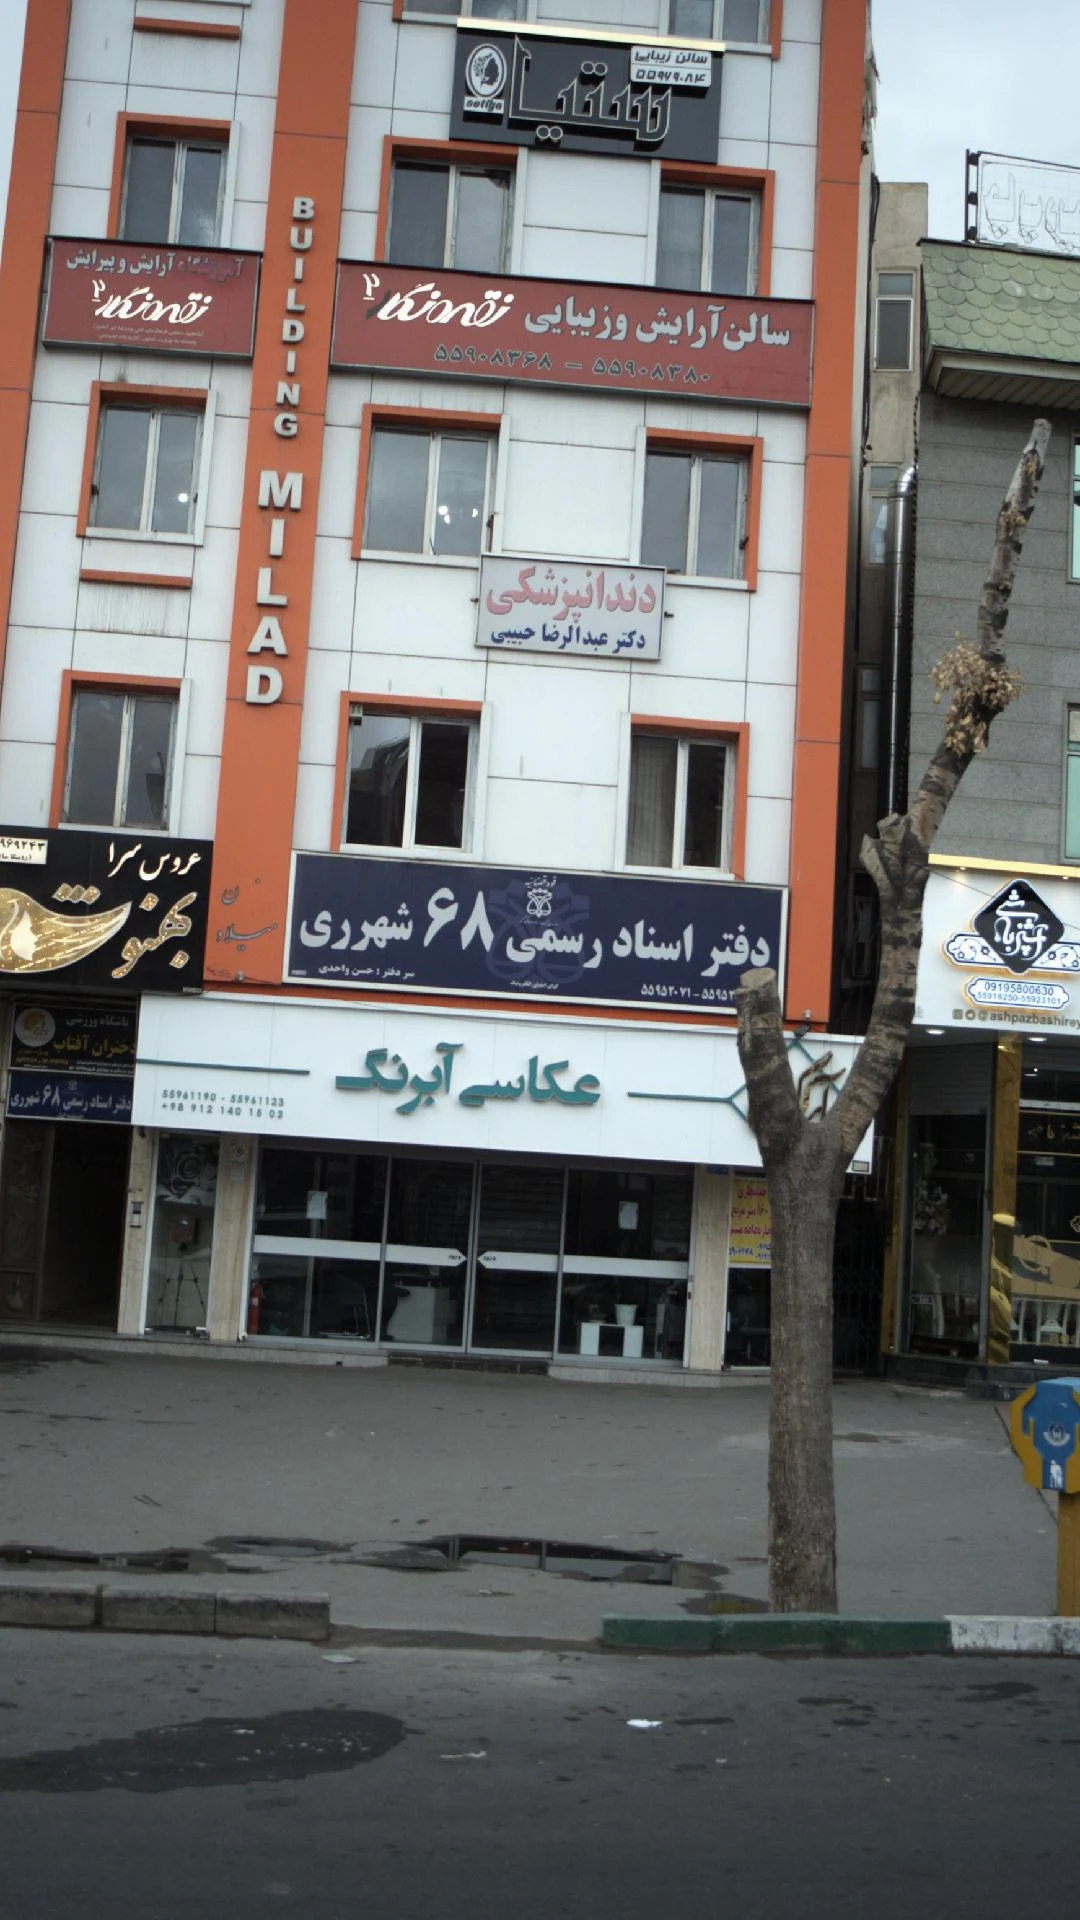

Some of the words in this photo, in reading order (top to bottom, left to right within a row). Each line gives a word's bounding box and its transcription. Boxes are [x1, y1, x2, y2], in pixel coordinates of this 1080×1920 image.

[635, 50, 671, 64] زیبایی
[675, 52, 708, 65] سالن
[66, 248, 116, 274] پیرایش
[118, 257, 126, 274] و
[129, 252, 176, 277] آرایش
[273, 196, 315, 438] BUILDING
[524, 296, 610, 340] زیبایی
[611, 312, 629, 341] و
[635, 304, 725, 349] آرایش
[723, 311, 791, 351] سالن
[434, 344, 552, 370] ۵۵۹۰۸۳۶۸
[592, 356, 711, 384] ۵۵۹۰۸۳۸۰
[245, 470, 304, 706] MILAD
[486, 565, 657, 624] دندانپزشکی
[491, 626, 535, 646] حبیبی
[541, 623, 608, 651] عبدالرضا
[611, 629, 646, 654] دکتر
[108, 842, 141, 877] سرا
[138, 852, 201, 881] عروس
[423, 887, 494, 952] ۶۸
[216, 922, 278, 953] میلاد
[506, 929, 603, 969] رسمی
[612, 919, 694, 963] اسناد
[701, 923, 770, 977] دفتر
[318, 963, 350, 976] واحدی
[351, 964, 374, 976] حسن
[335, 1042, 464, 1116] آبرنگ
[459, 1055, 601, 1106] عکاسی
[42, 1084, 60, 1107] ۶۸
[62, 1096, 89, 1112] رسمی
[90, 1094, 112, 1109] اسناد
[113, 1094, 132, 1114] دفتر
[161, 1089, 217, 1102] 55961190
[230, 1094, 285, 1108] 55961123
[161, 1102, 184, 1112] +98
[191, 1103, 213, 1114] 912
[220, 1106, 242, 1116] 140
